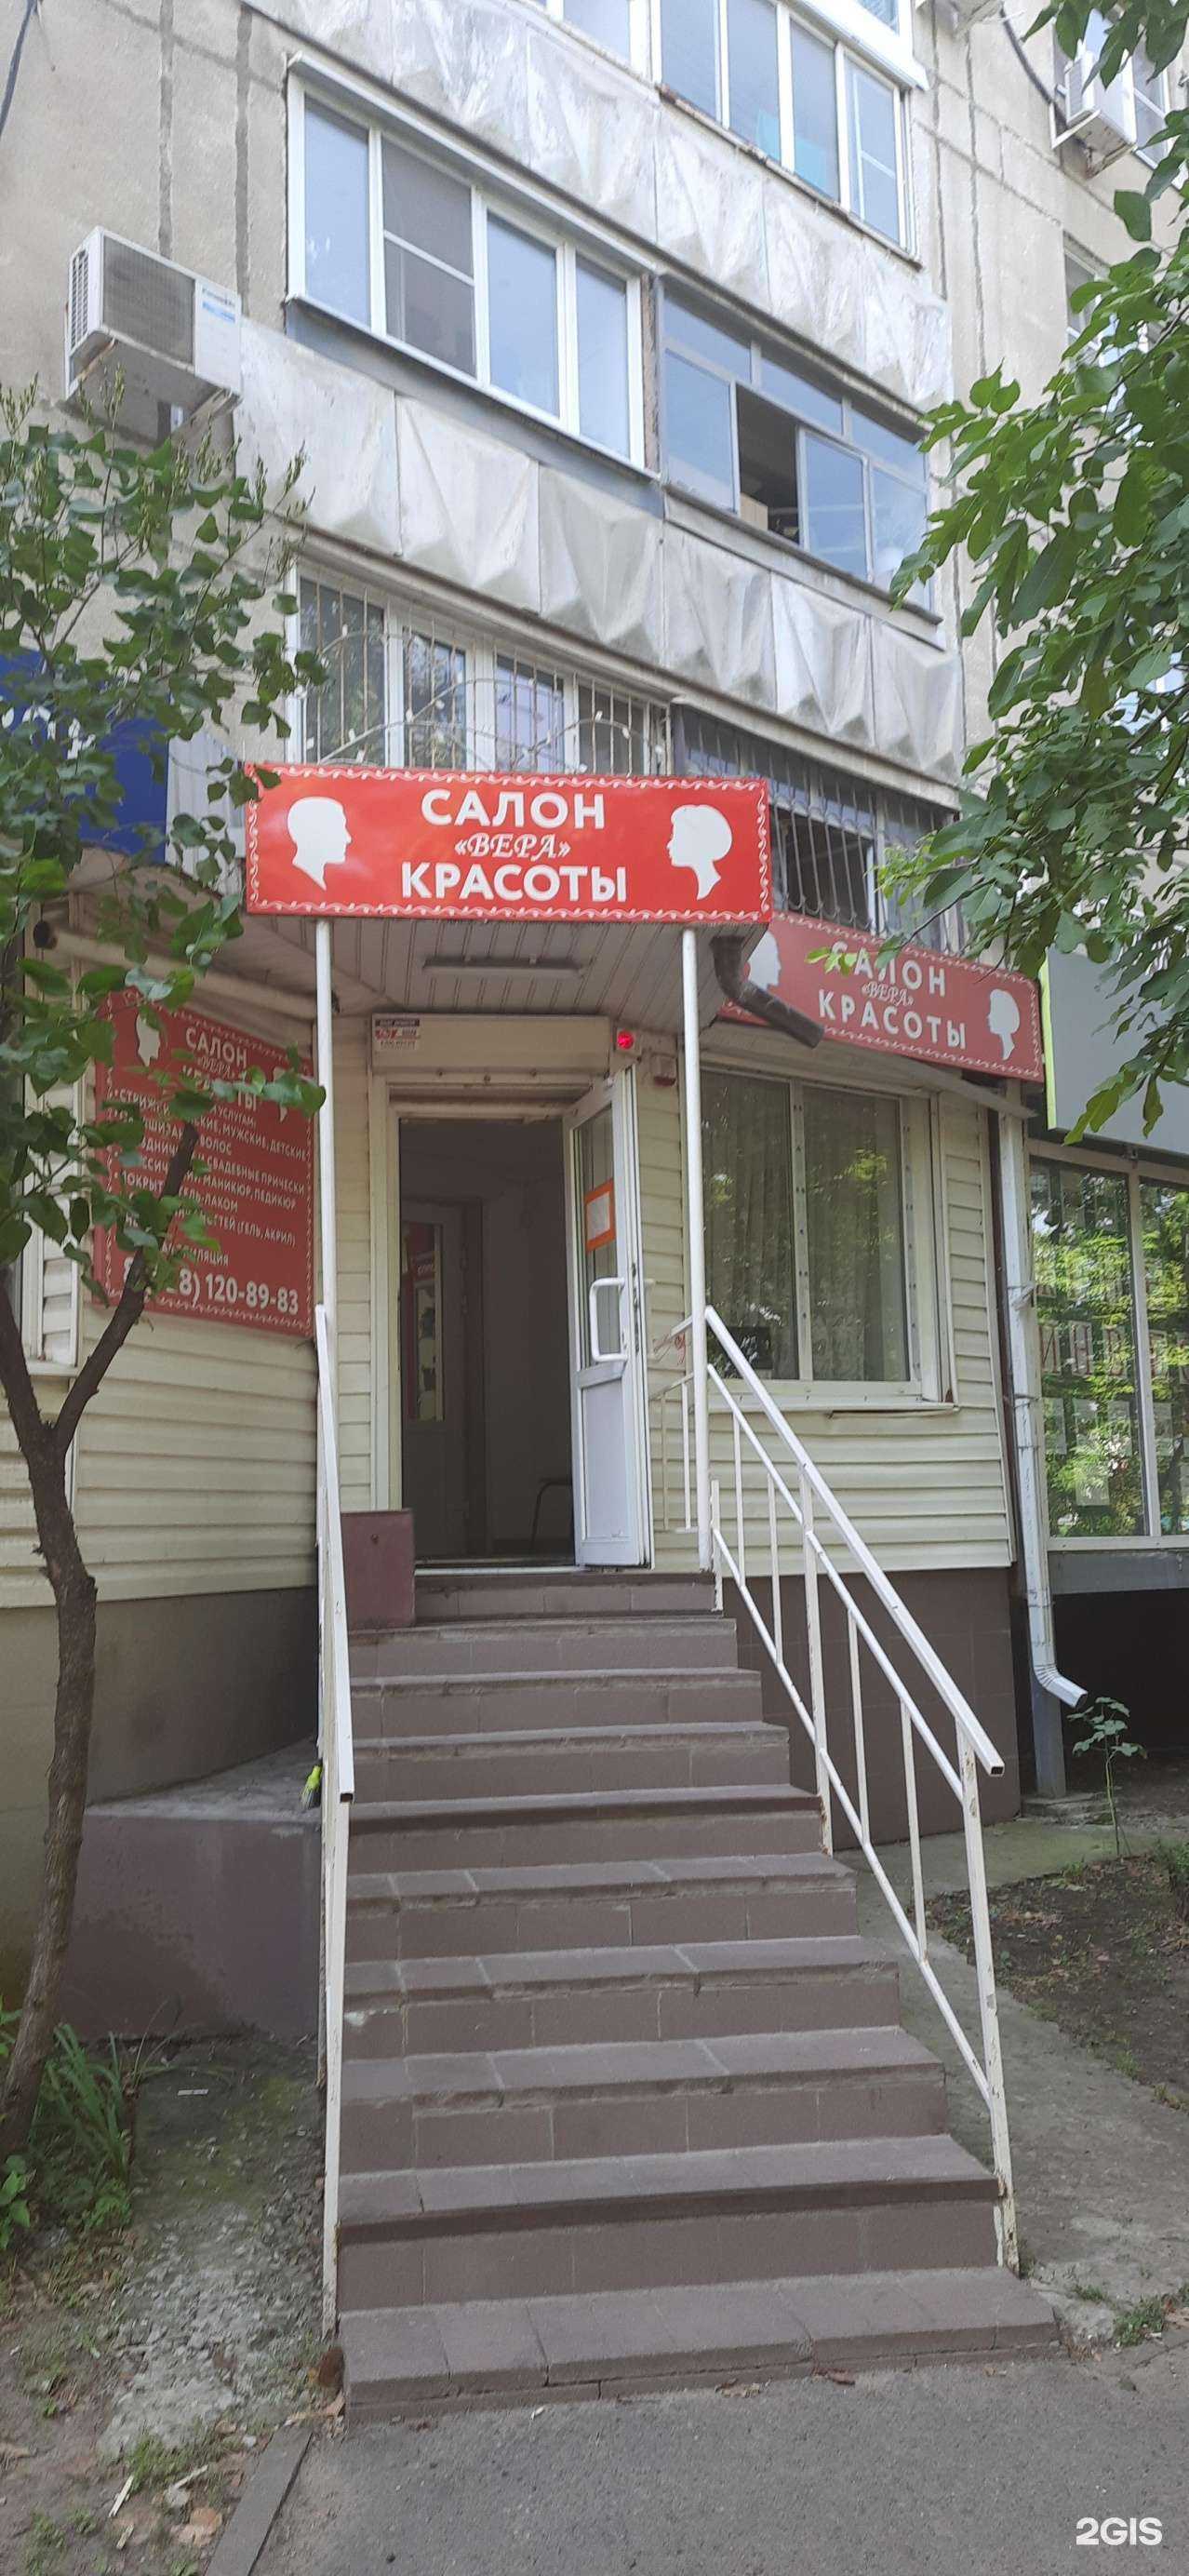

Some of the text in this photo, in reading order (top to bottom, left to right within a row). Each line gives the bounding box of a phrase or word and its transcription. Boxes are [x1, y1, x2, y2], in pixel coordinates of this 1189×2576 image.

[421, 789, 606, 830] САЛОН
[454, 832, 572, 861] «ВЕРА»
[401, 862, 627, 903] КРАСОТЫ
[818, 988, 967, 1050] КРАСОТЫ
[186, 1026, 247, 1069] САЛОН
[205, 1272, 299, 1315] 120-89-83
